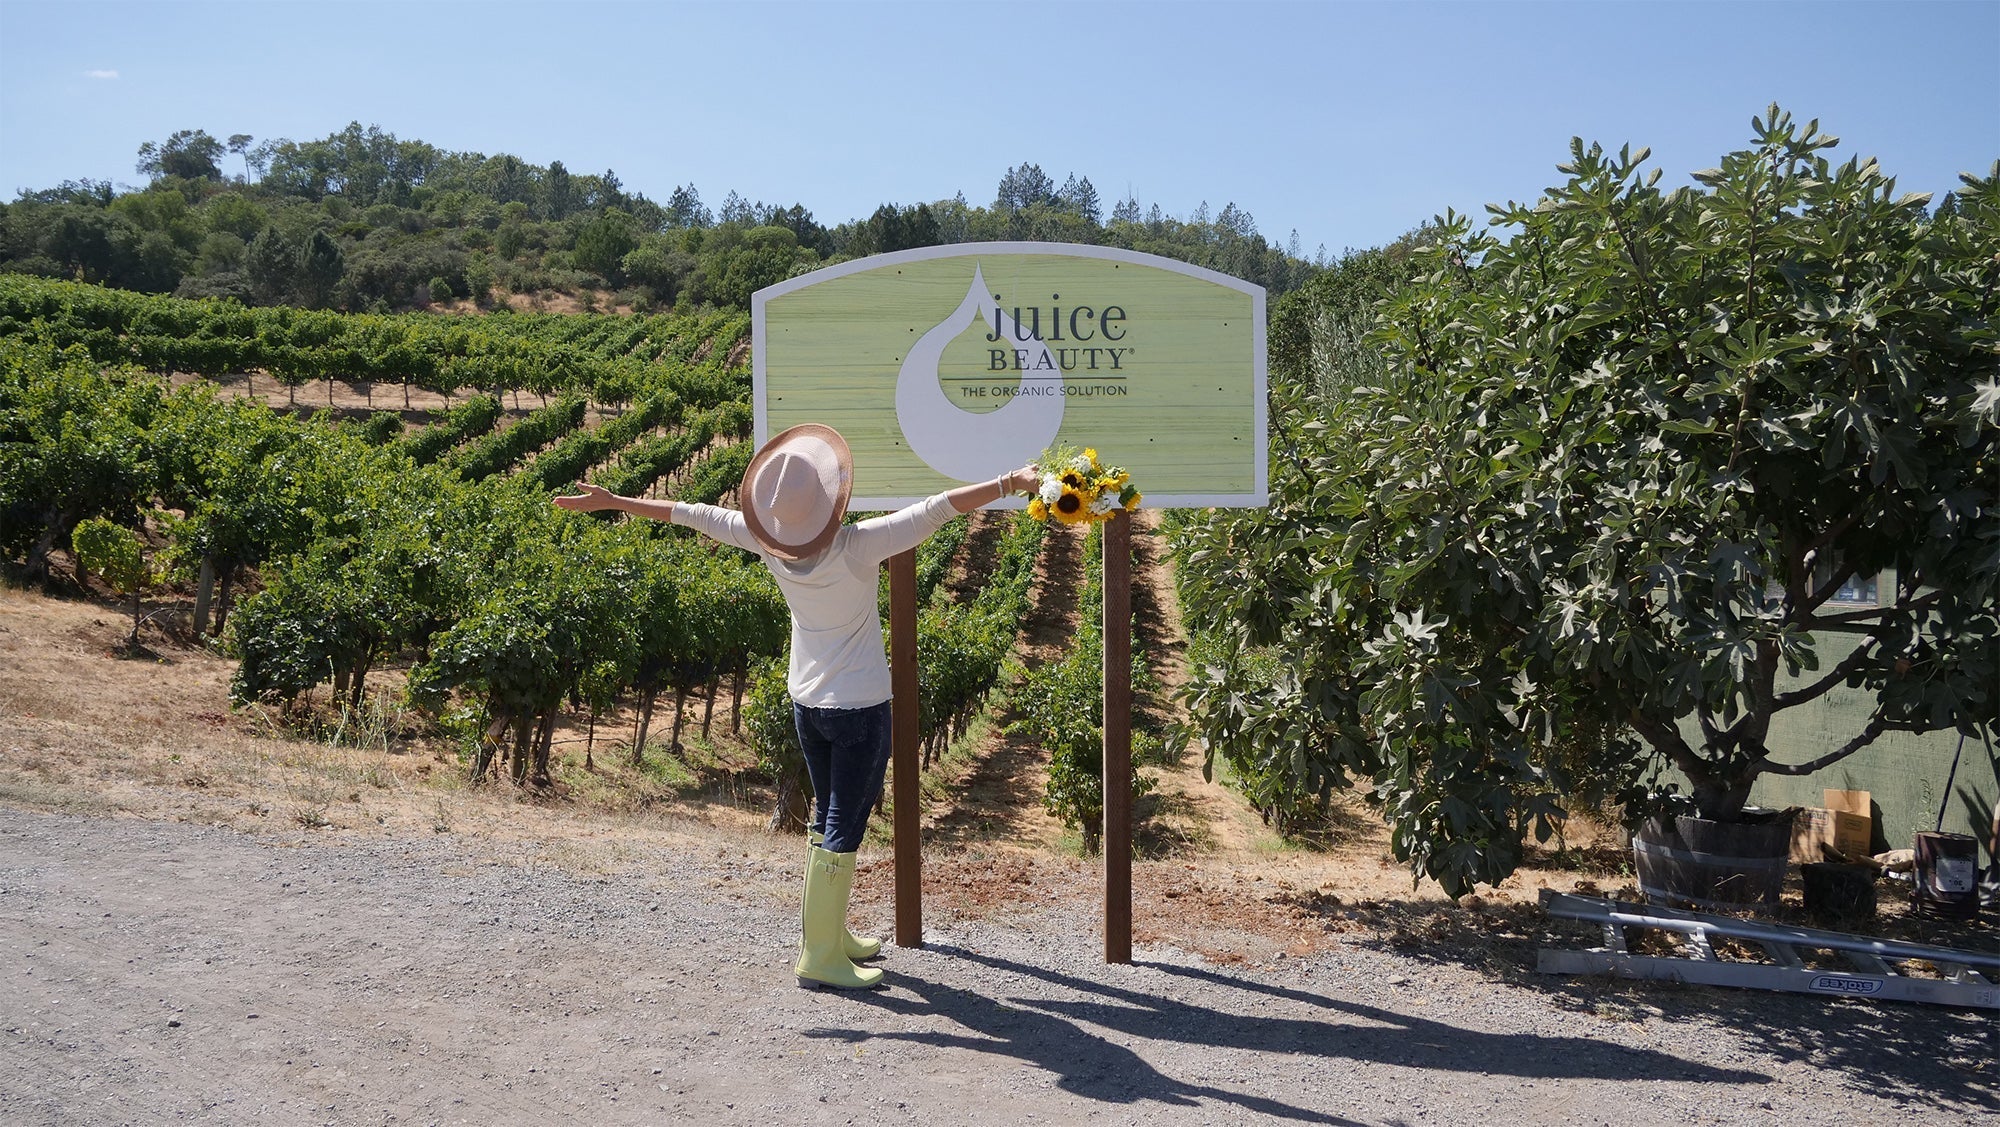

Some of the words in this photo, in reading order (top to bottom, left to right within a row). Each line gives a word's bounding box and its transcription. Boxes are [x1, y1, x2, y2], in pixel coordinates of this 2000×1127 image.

[986, 293, 1127, 342] juice
[961, 387, 986, 396] THE
[991, 386, 1054, 396] ORGANIC
[1059, 385, 1127, 396] SOLUTION
[1820, 977, 1873, 991] stokes
